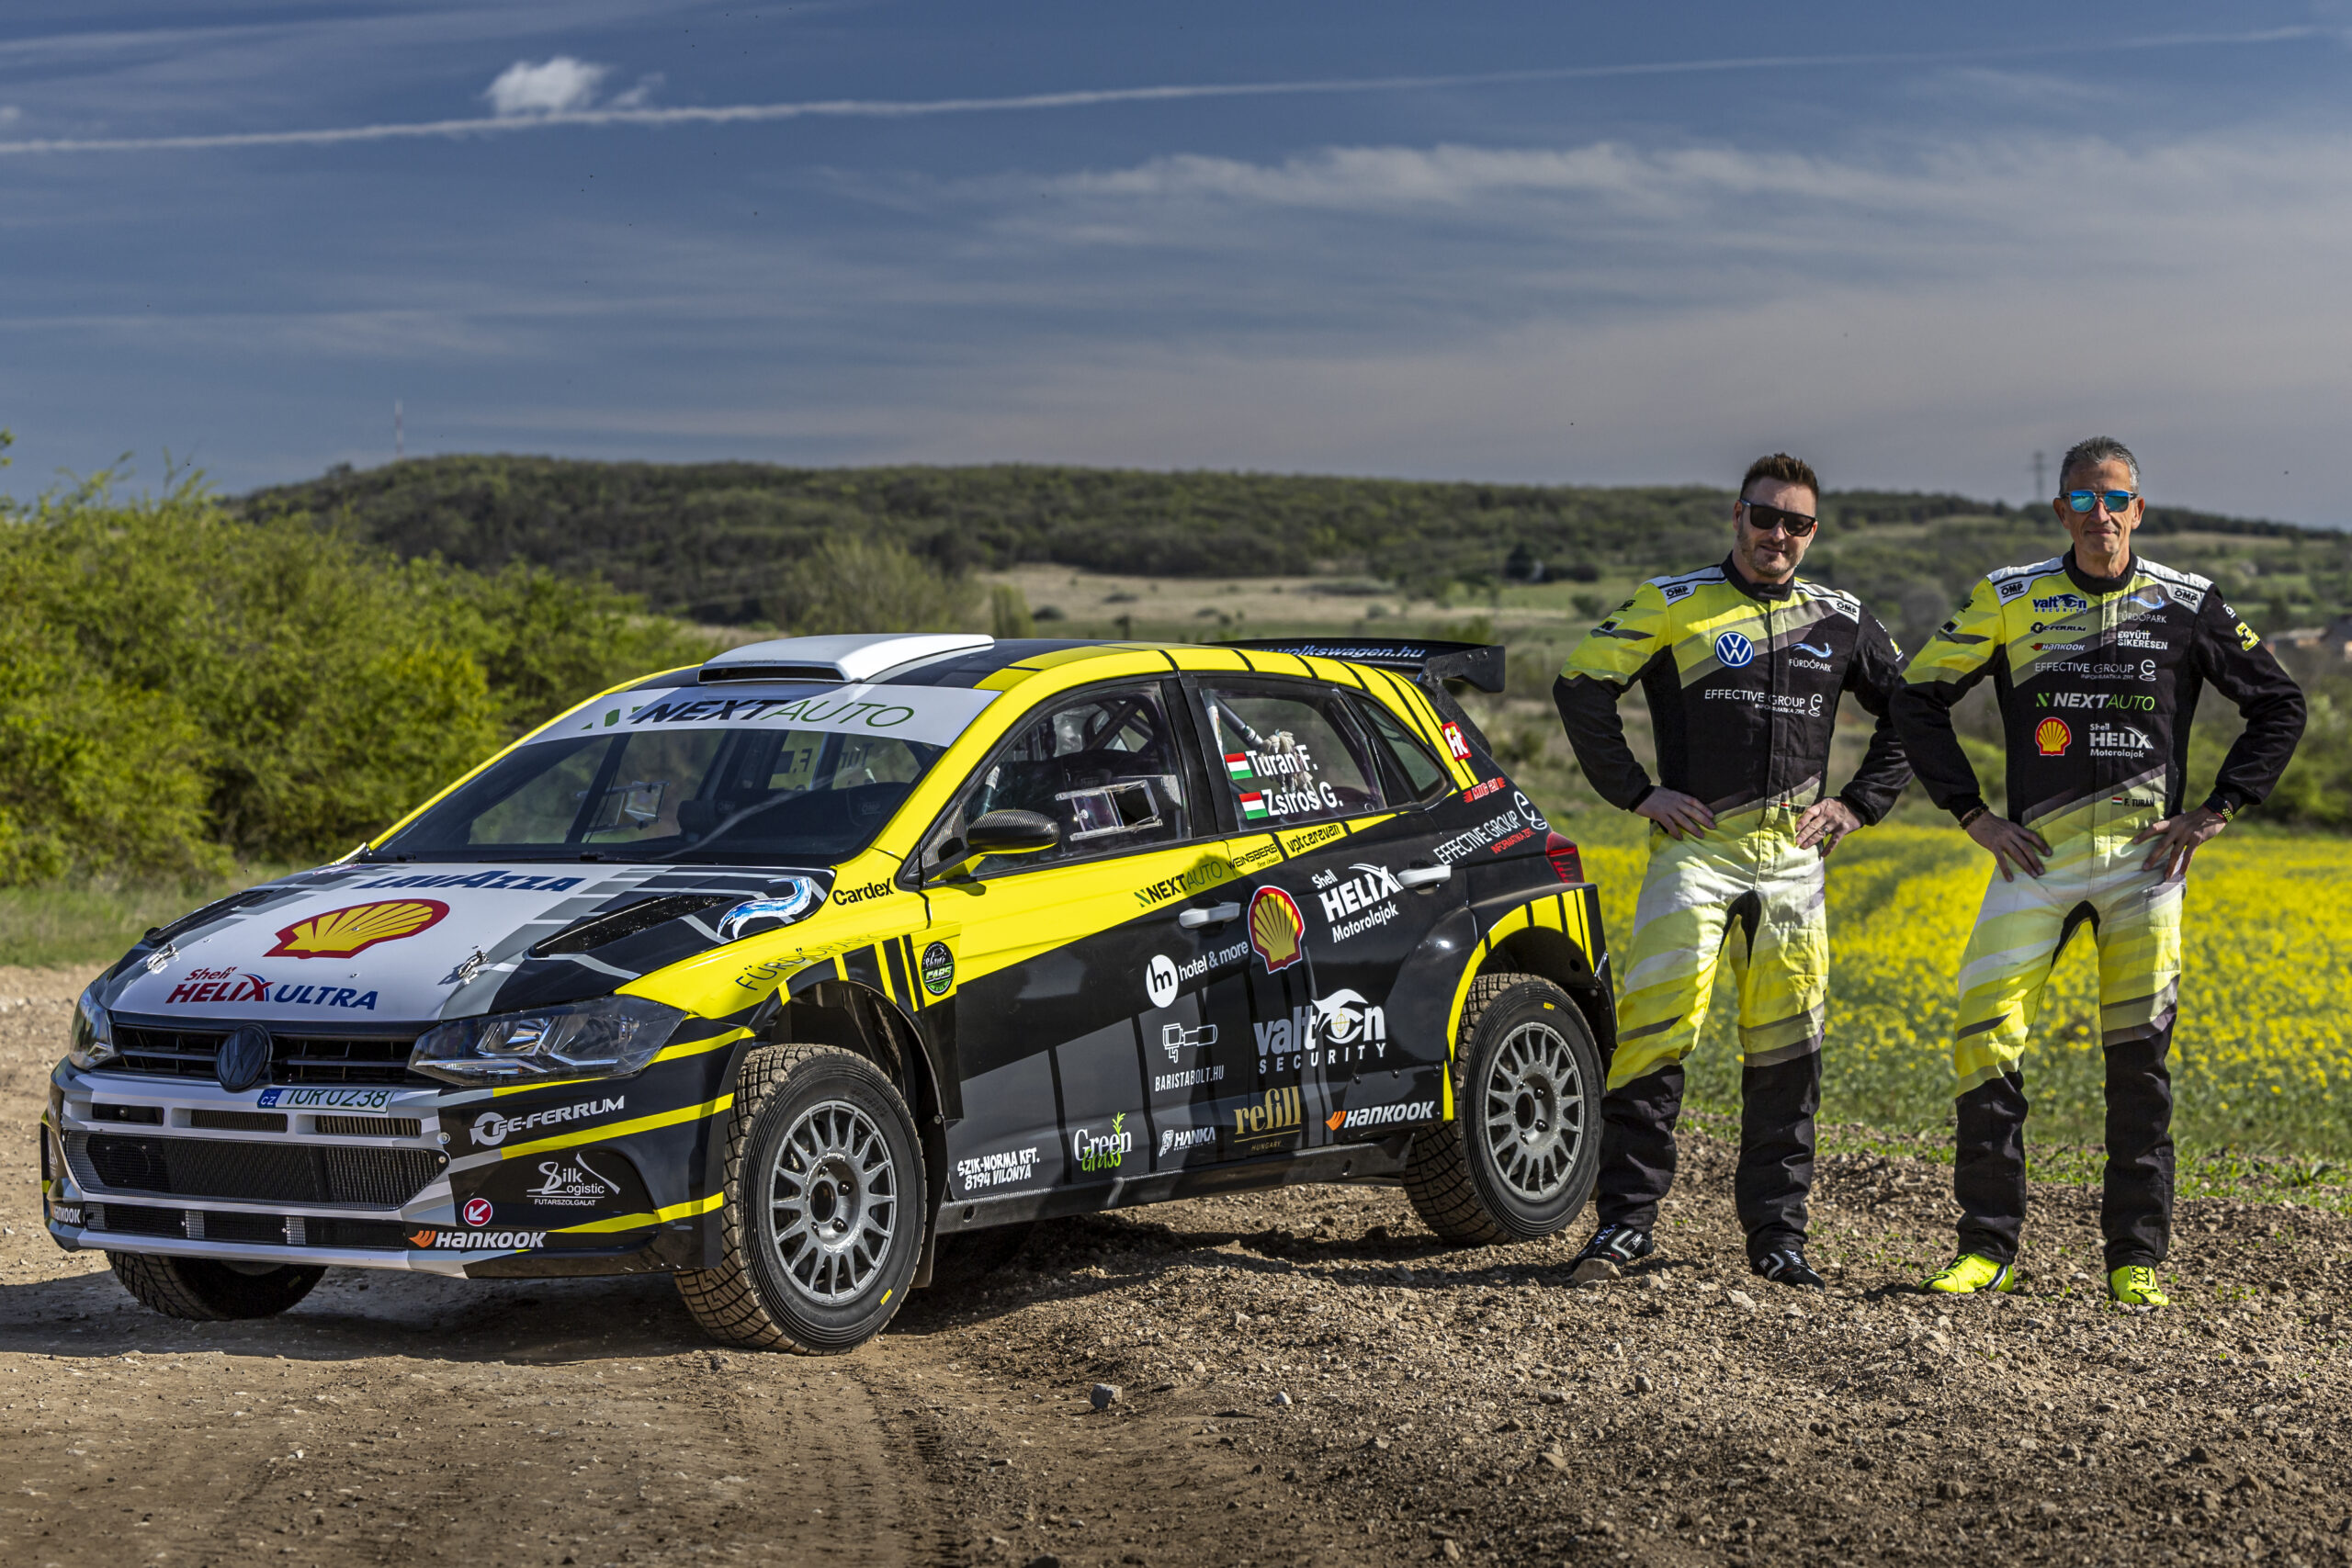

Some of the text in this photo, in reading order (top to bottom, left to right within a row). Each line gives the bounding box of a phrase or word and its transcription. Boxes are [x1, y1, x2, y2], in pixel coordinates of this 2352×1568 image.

[1666, 586, 1689, 597] OMP
[2001, 583, 2023, 595] OMP
[2175, 590, 2197, 603] OMP
[2118, 638, 2168, 650] SIKERESEN
[2035, 662, 2134, 673] EFFECTIVE GROUP
[1704, 689, 1806, 707] EFFECTIVE GROUP
[2089, 723, 2110, 731] Shell
[2089, 728, 2154, 750] HELIX
[1297, 745, 1318, 773] F.
[2090, 749, 2144, 760] Motorolajok
[1320, 781, 1344, 809] G.
[1472, 782, 1487, 800] MIG
[1433, 810, 1521, 865] EFFECTIVE GROUP
[1311, 869, 1338, 890] Shell
[832, 878, 894, 906] Cardex
[1318, 864, 1405, 922] HELIX
[1332, 901, 1400, 943] Motorolajok
[184, 966, 238, 981] Shell
[1178, 941, 1250, 983] hotel & more
[165, 974, 379, 1010] HELIX ULTRA
[1260, 1043, 1386, 1075] SECURITY
[1155, 1066, 1225, 1092] BARISTABOLT.HU
[260, 1096, 277, 1106] CZ
[1234, 1086, 1301, 1135] refill
[1074, 1128, 1132, 1161] Green
[1174, 1126, 1216, 1147] HANKA
[1251, 1140, 1283, 1152] HUNGARY
[957, 1147, 1040, 1179] SZIK-NORMA KFT.
[1082, 1148, 1122, 1172] Grass
[538, 1161, 582, 1192] Silk
[965, 1163, 1032, 1190] 8194 VILONYA
